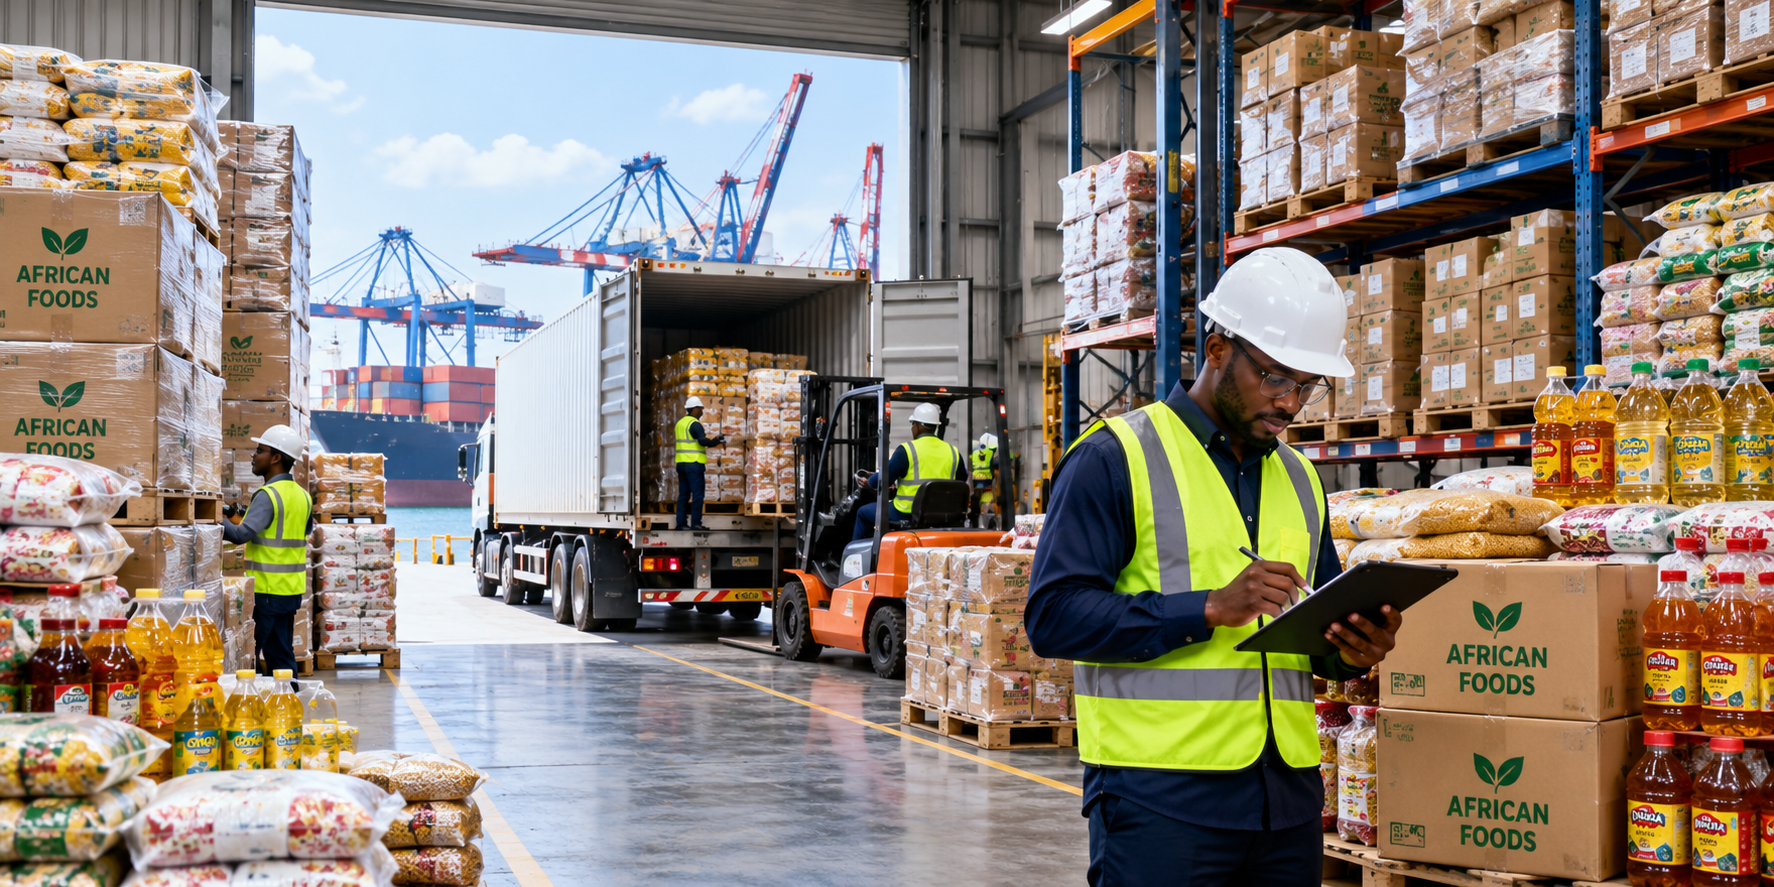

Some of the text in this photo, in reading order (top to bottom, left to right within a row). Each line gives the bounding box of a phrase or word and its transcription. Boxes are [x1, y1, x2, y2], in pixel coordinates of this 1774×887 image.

[16, 265, 110, 285] AFRICAN
[28, 289, 98, 309] FOODS
[14, 417, 107, 437] AFRICAN
[26, 441, 95, 460] FOODS
[1446, 643, 1548, 669] AFRICAN
[1459, 671, 1536, 696] FOODS
[1447, 795, 1549, 825] AFRICAN
[1460, 824, 1537, 853] FOODS
